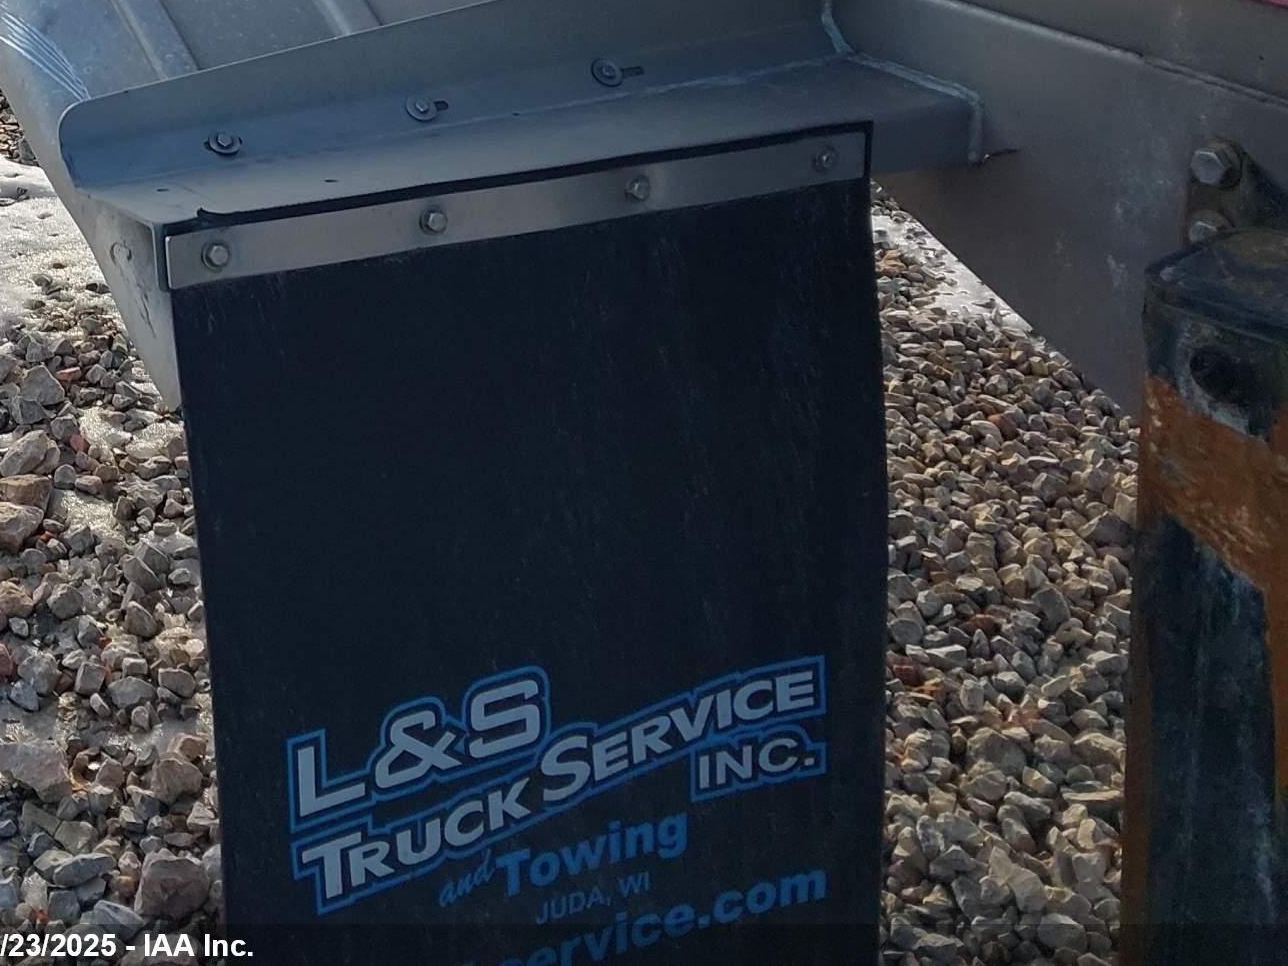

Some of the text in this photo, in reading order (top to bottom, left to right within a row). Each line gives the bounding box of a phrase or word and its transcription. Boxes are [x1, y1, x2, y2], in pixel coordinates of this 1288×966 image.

[296, 679, 541, 817] L&S
[301, 670, 815, 900] TRUCK SERVICE
[698, 737, 815, 790] INC.
[439, 812, 688, 908] and Towing
[535, 871, 651, 925] JUDA, WI
